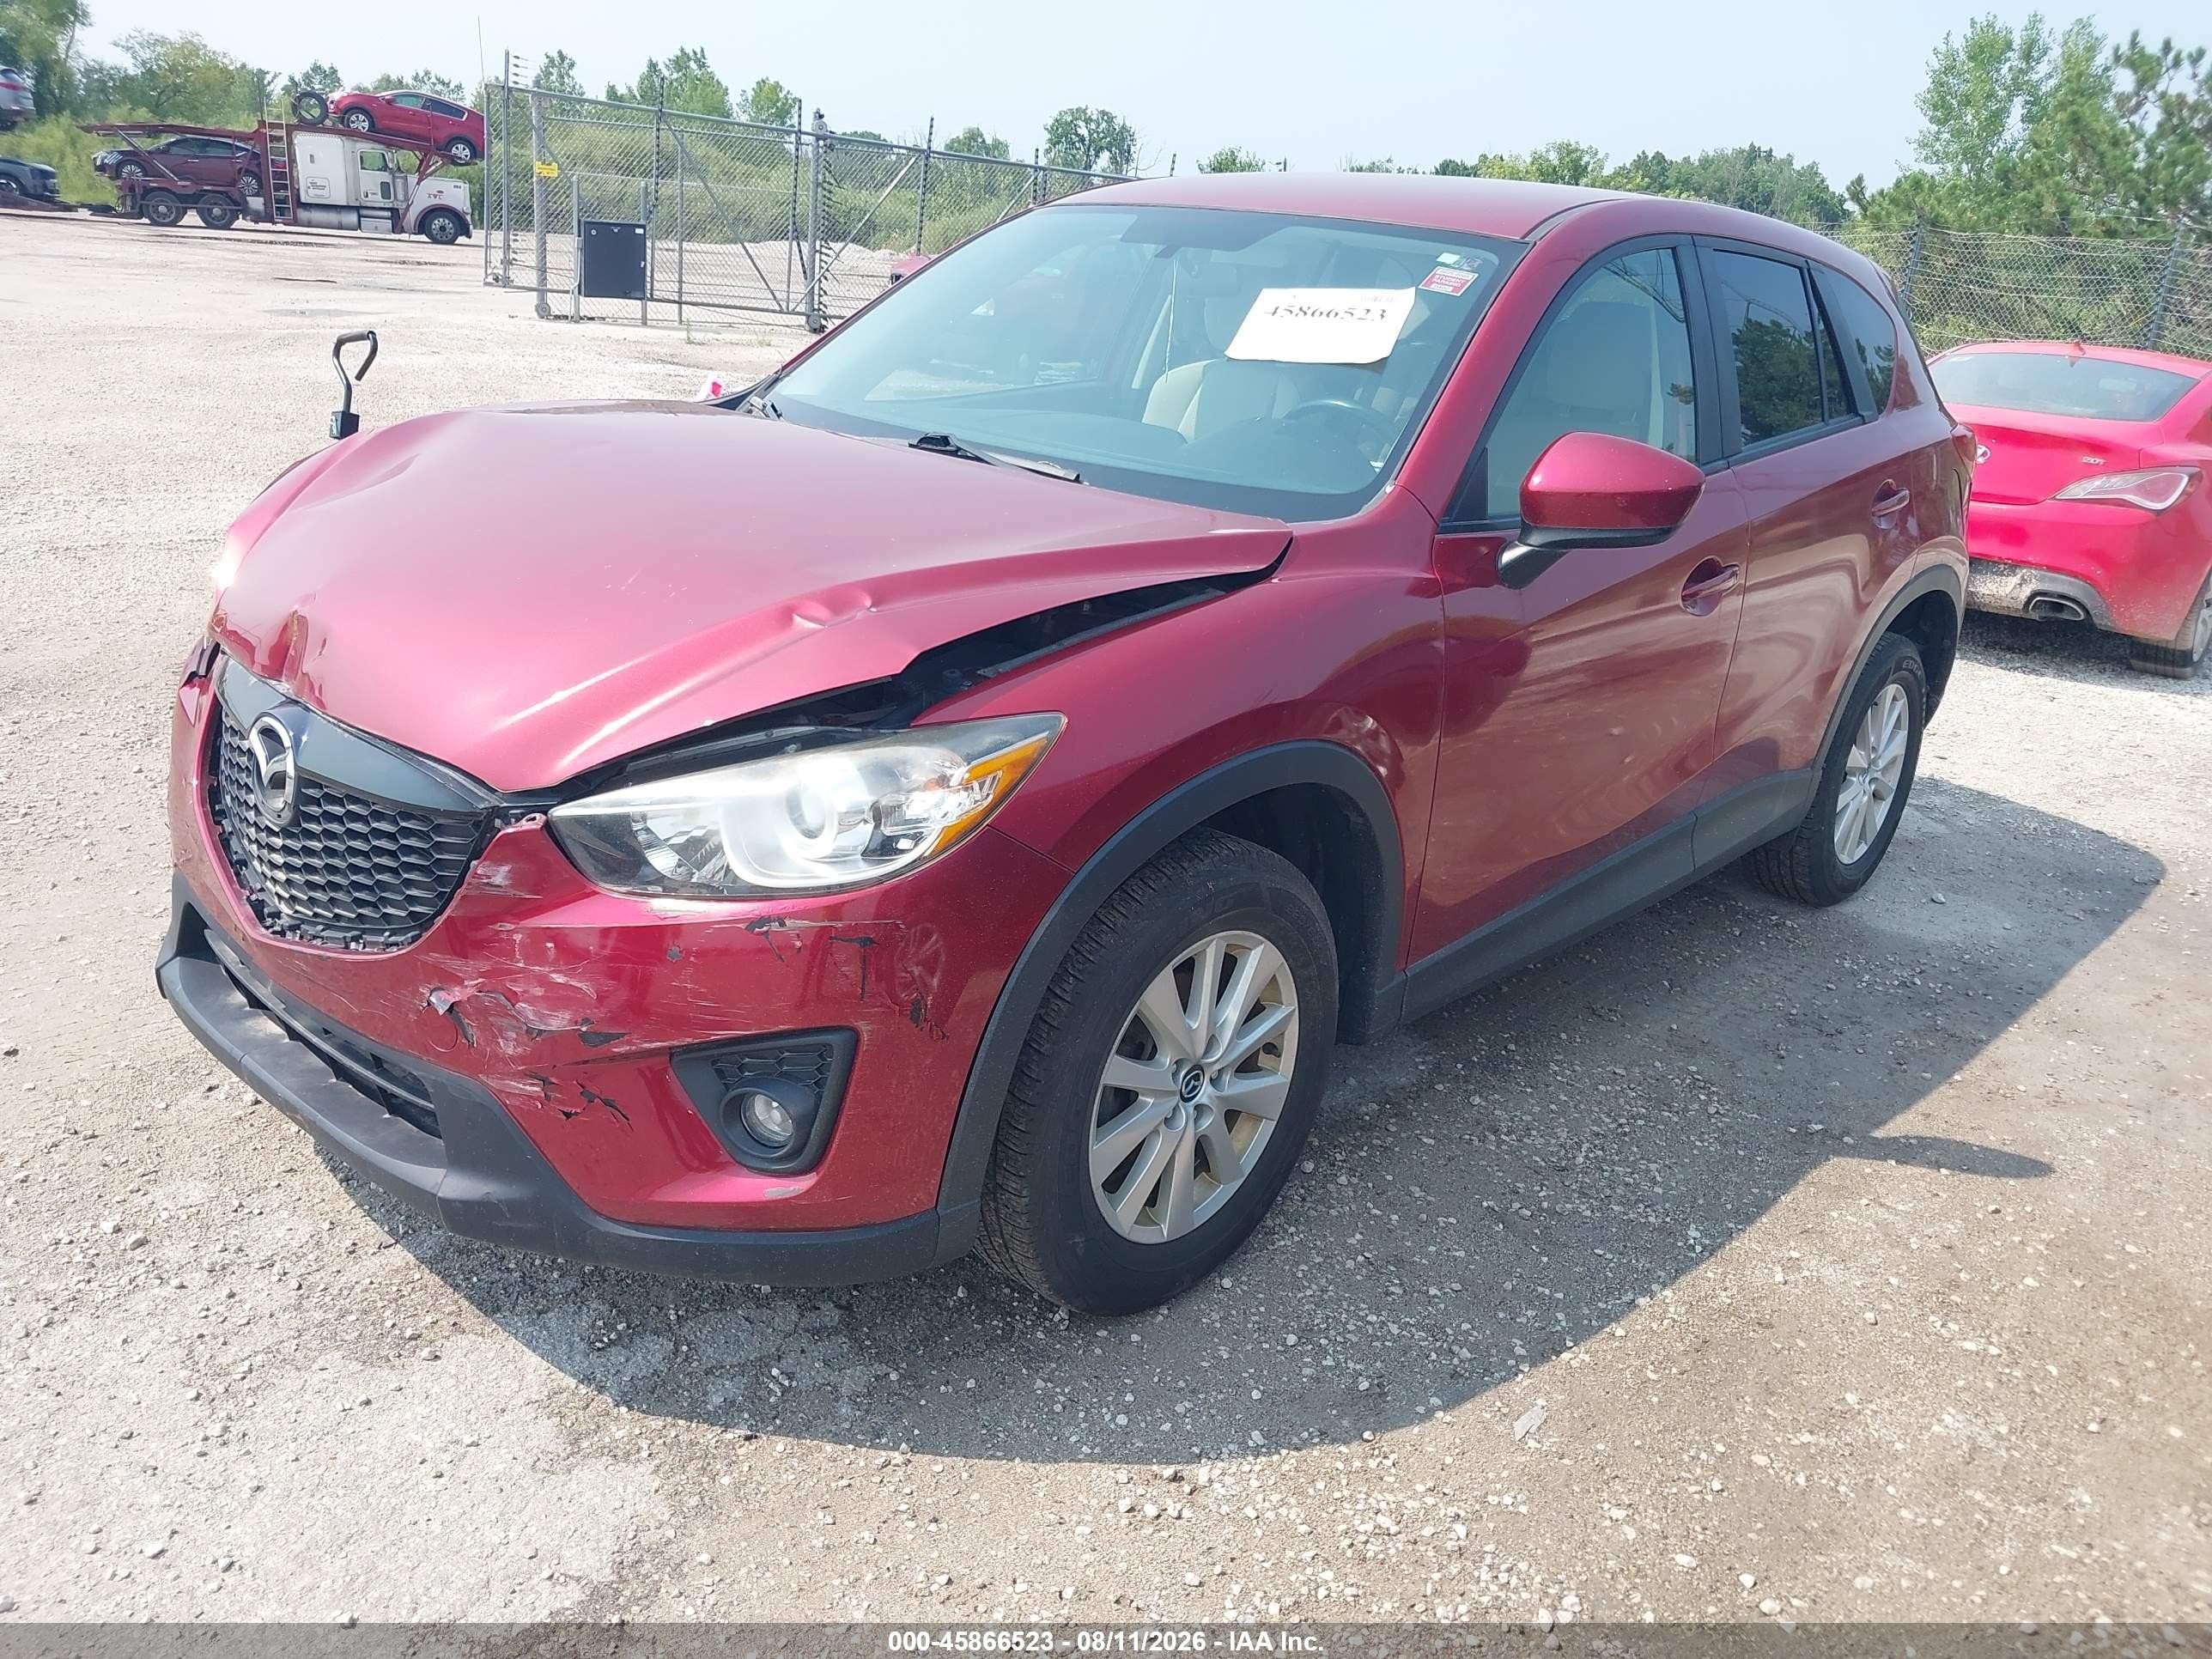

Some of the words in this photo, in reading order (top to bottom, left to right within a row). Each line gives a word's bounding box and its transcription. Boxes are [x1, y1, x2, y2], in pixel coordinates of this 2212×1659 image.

[1431, 277, 1462, 288] PARKING
[1434, 273, 1466, 284] STUDENT
[1264, 305, 1387, 321] 45866523
